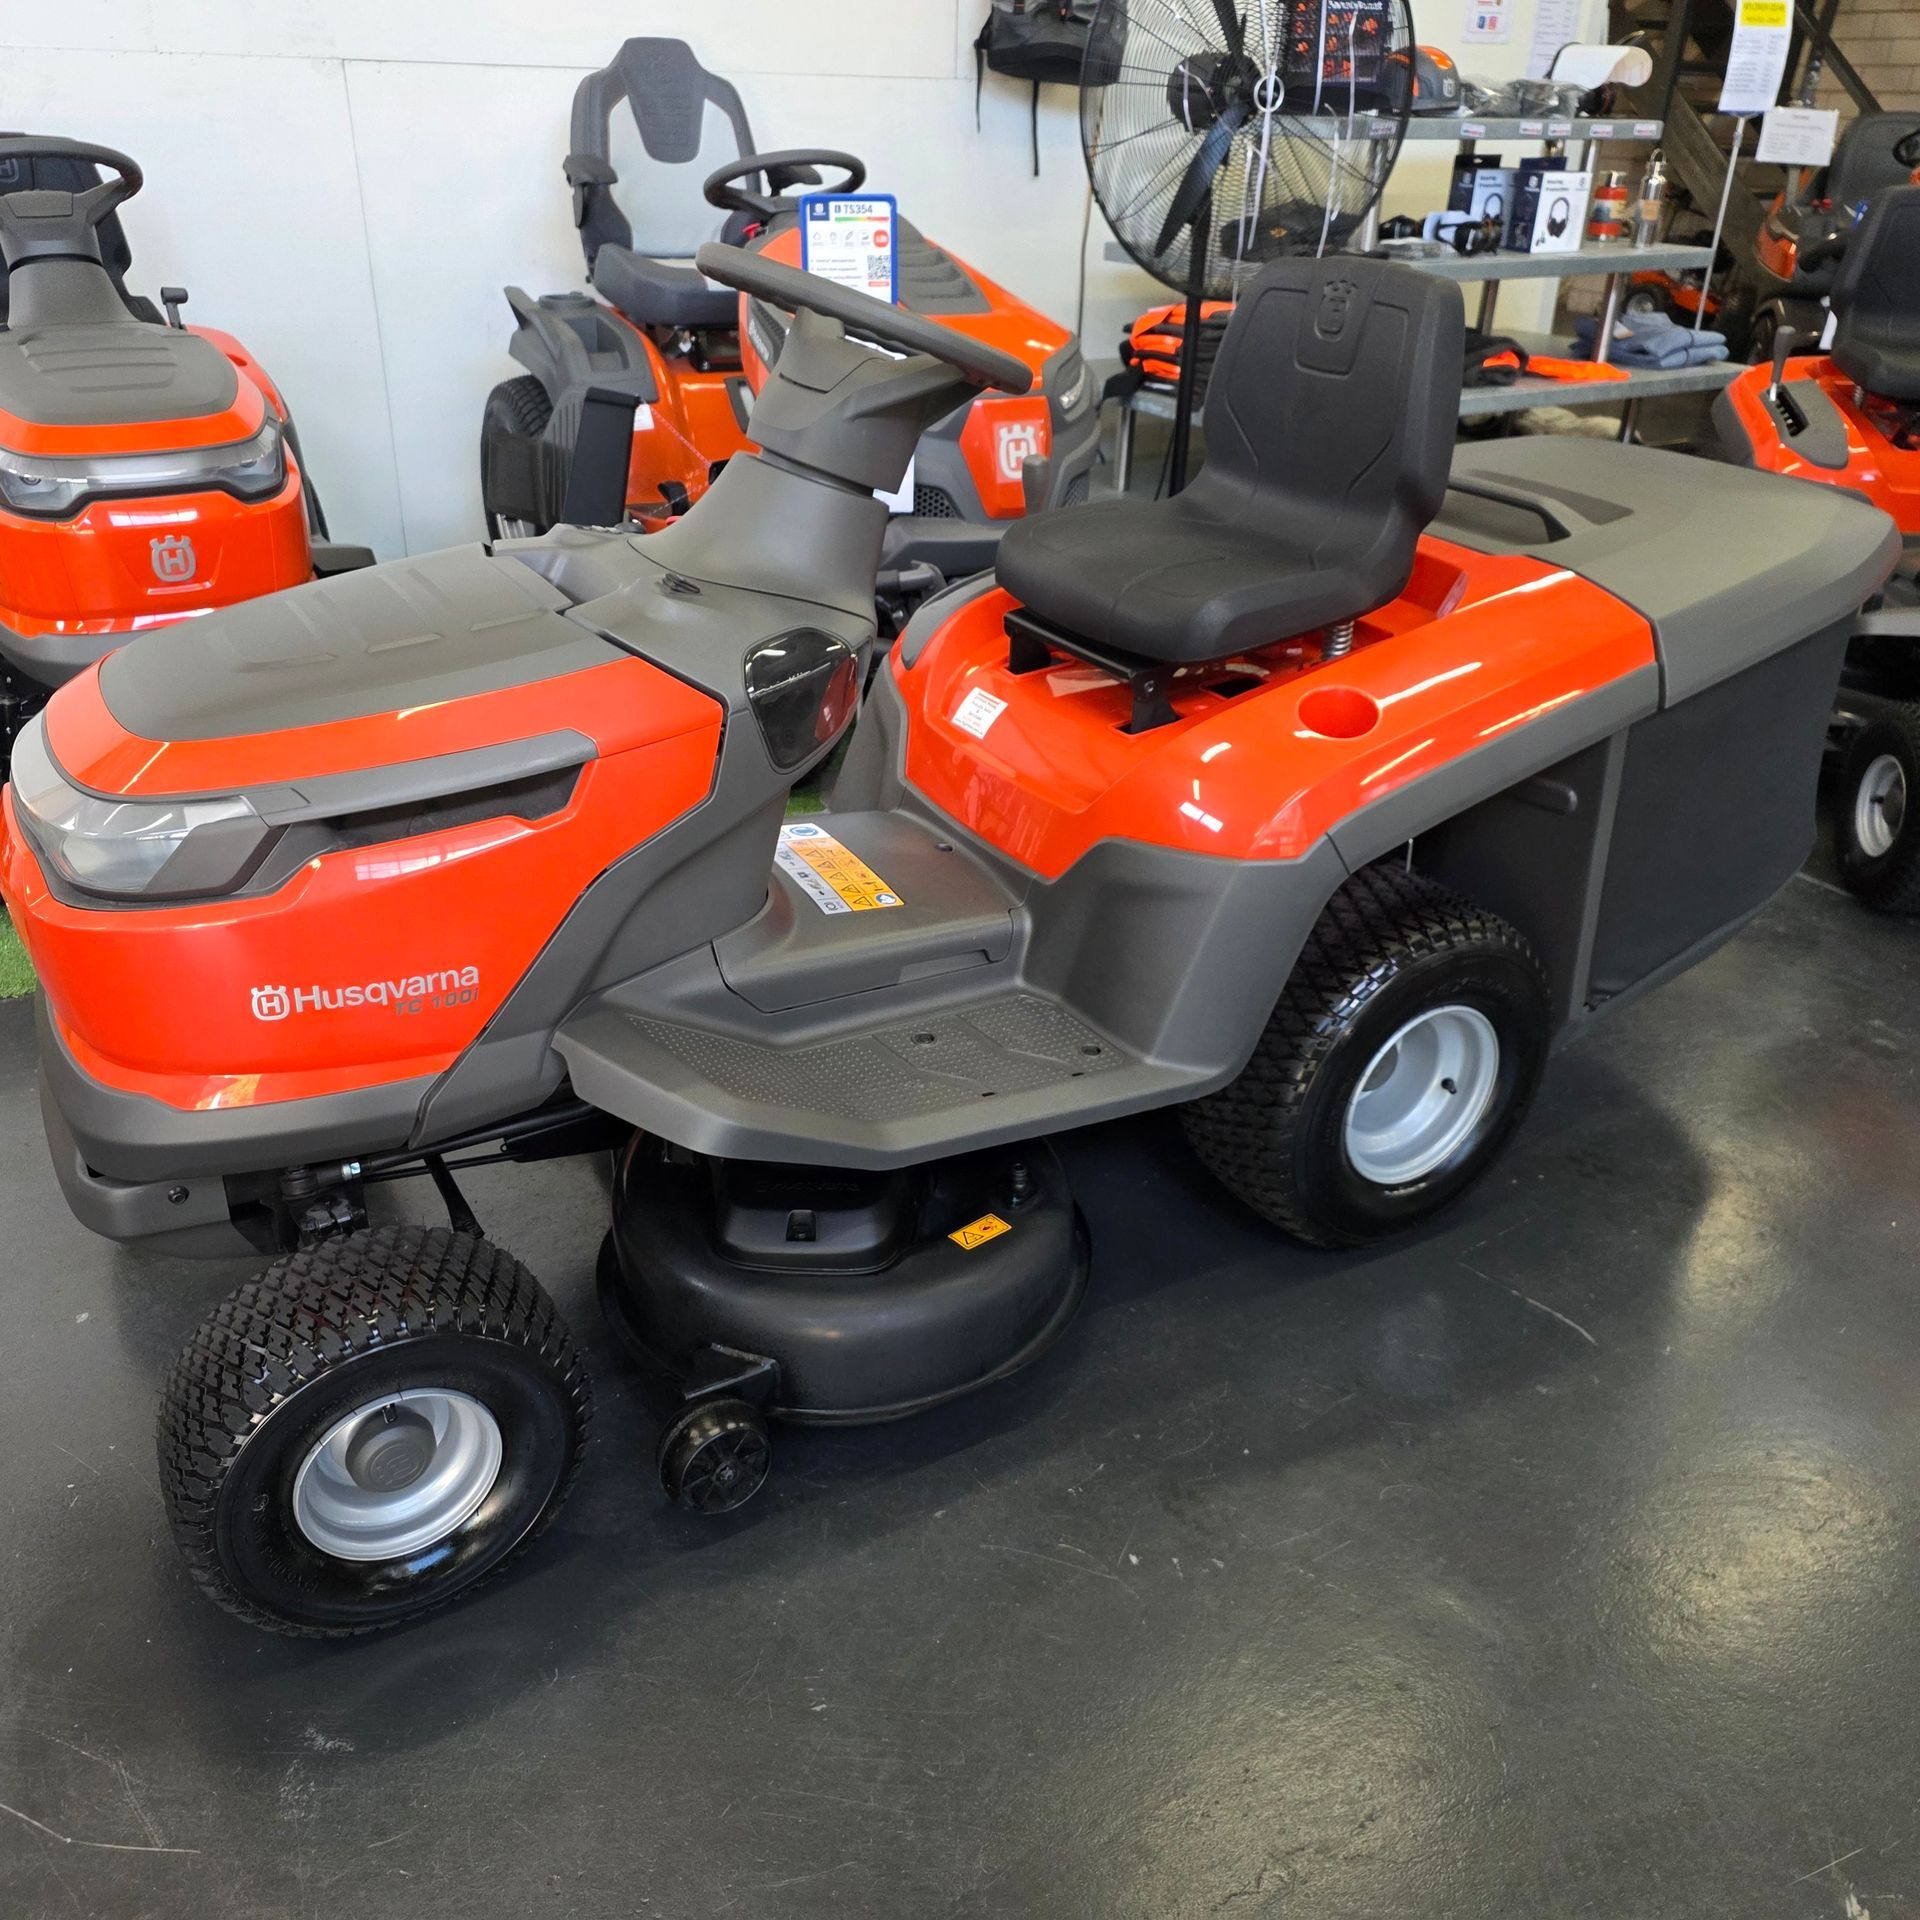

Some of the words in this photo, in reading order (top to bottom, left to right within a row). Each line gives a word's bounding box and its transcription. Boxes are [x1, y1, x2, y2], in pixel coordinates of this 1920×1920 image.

[844, 204, 873, 214] TS354
[293, 965, 480, 1013] Husqvarna
[394, 998, 422, 1016] TC
[431, 987, 479, 1008] 100i
